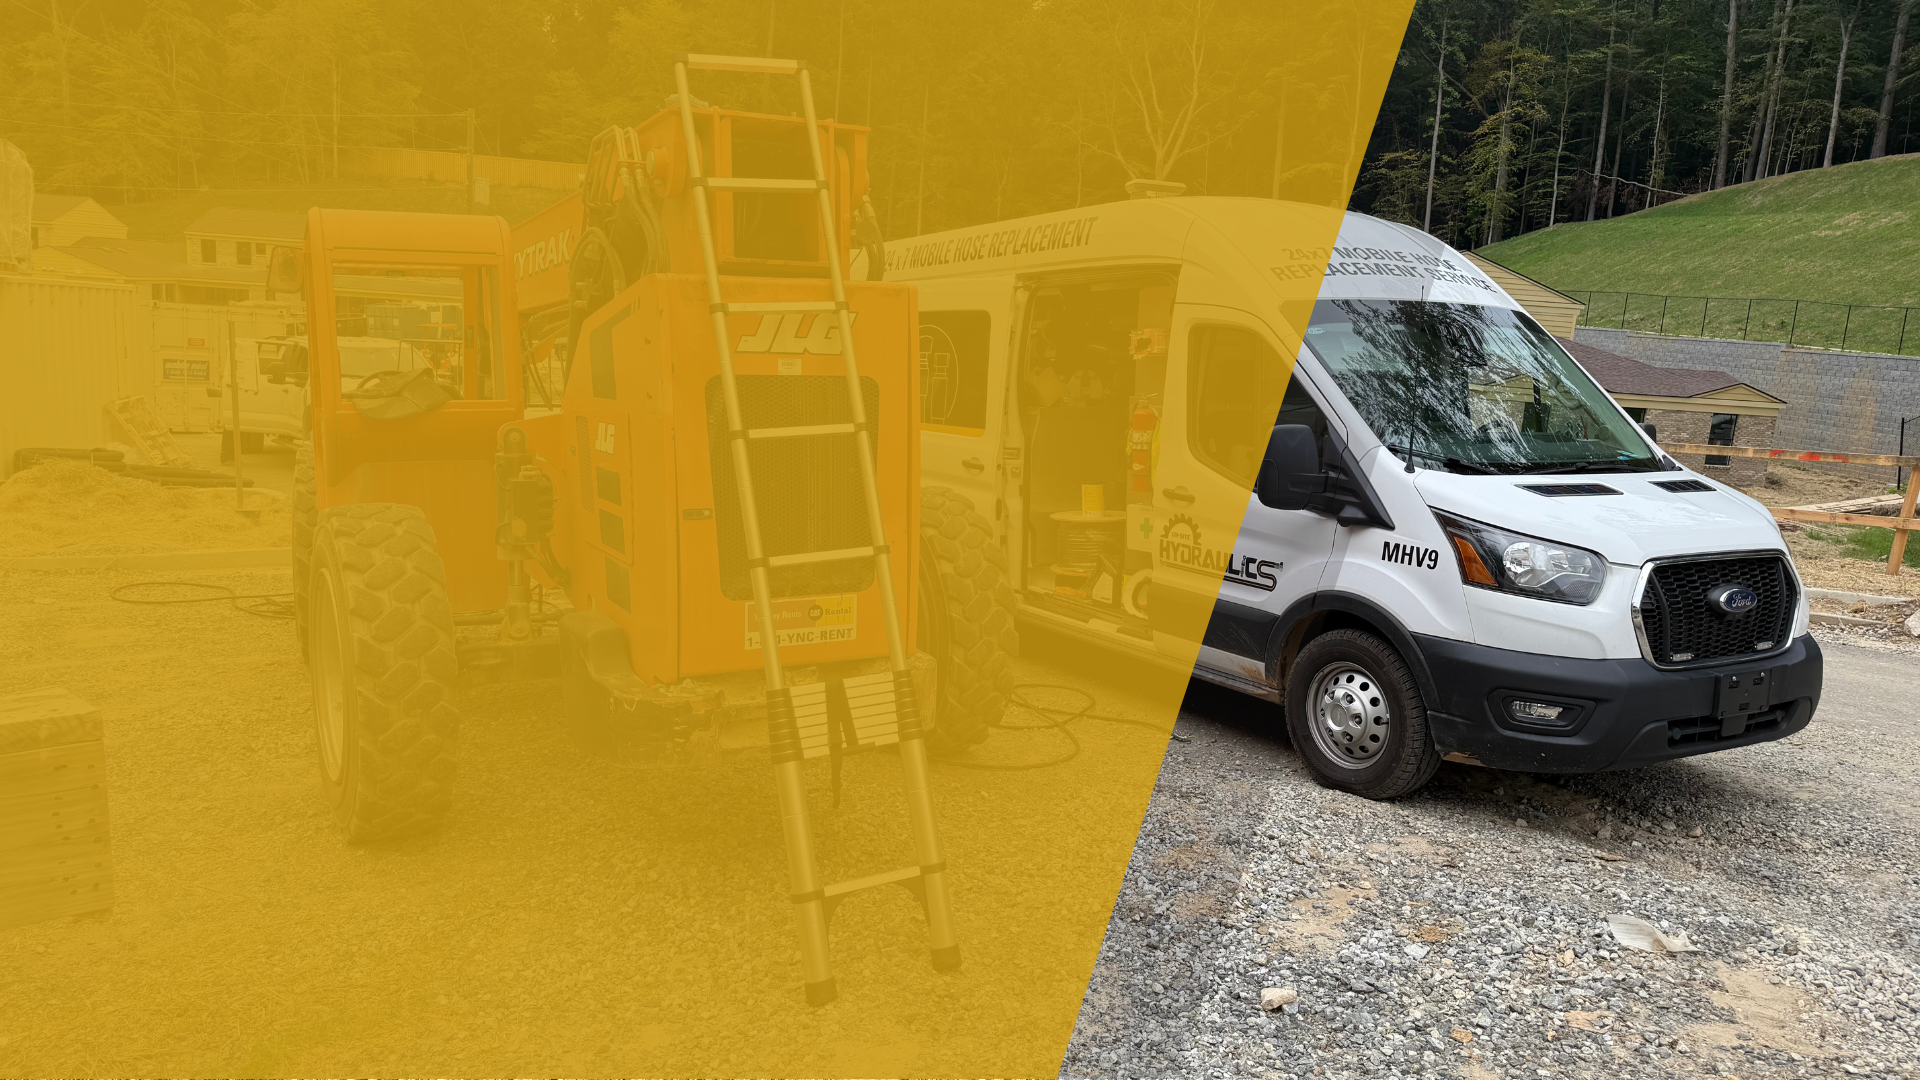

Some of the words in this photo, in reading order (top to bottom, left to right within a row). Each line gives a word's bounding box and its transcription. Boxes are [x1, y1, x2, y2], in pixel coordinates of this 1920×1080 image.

[513, 225, 573, 282] YTRAK
[884, 250, 896, 272] 24
[902, 247, 911, 270] 7
[909, 239, 954, 269] MOBILE
[953, 233, 989, 263] HOSE
[987, 216, 1099, 259] REPLACEMENT
[1281, 246, 1332, 261] 24x7
[1331, 246, 1413, 265] MOBILE
[1409, 252, 1462, 273] HOSE
[1269, 262, 1426, 281] REPLACEMENT
[1423, 267, 1498, 294] SERVICE
[734, 312, 859, 356] JLG
[190, 362, 209, 370] mini
[594, 420, 616, 455] JLG
[1172, 532, 1191, 541] ON-SITE
[1159, 538, 1283, 592] HYDRAULICS
[1381, 540, 1439, 570] MHV9
[809, 609, 821, 617] CAT
[824, 606, 852, 616] Rental
[1731, 593, 1752, 607] Ford
[782, 610, 803, 619] Rents
[747, 628, 854, 648] 1-4-YNC-RENT
